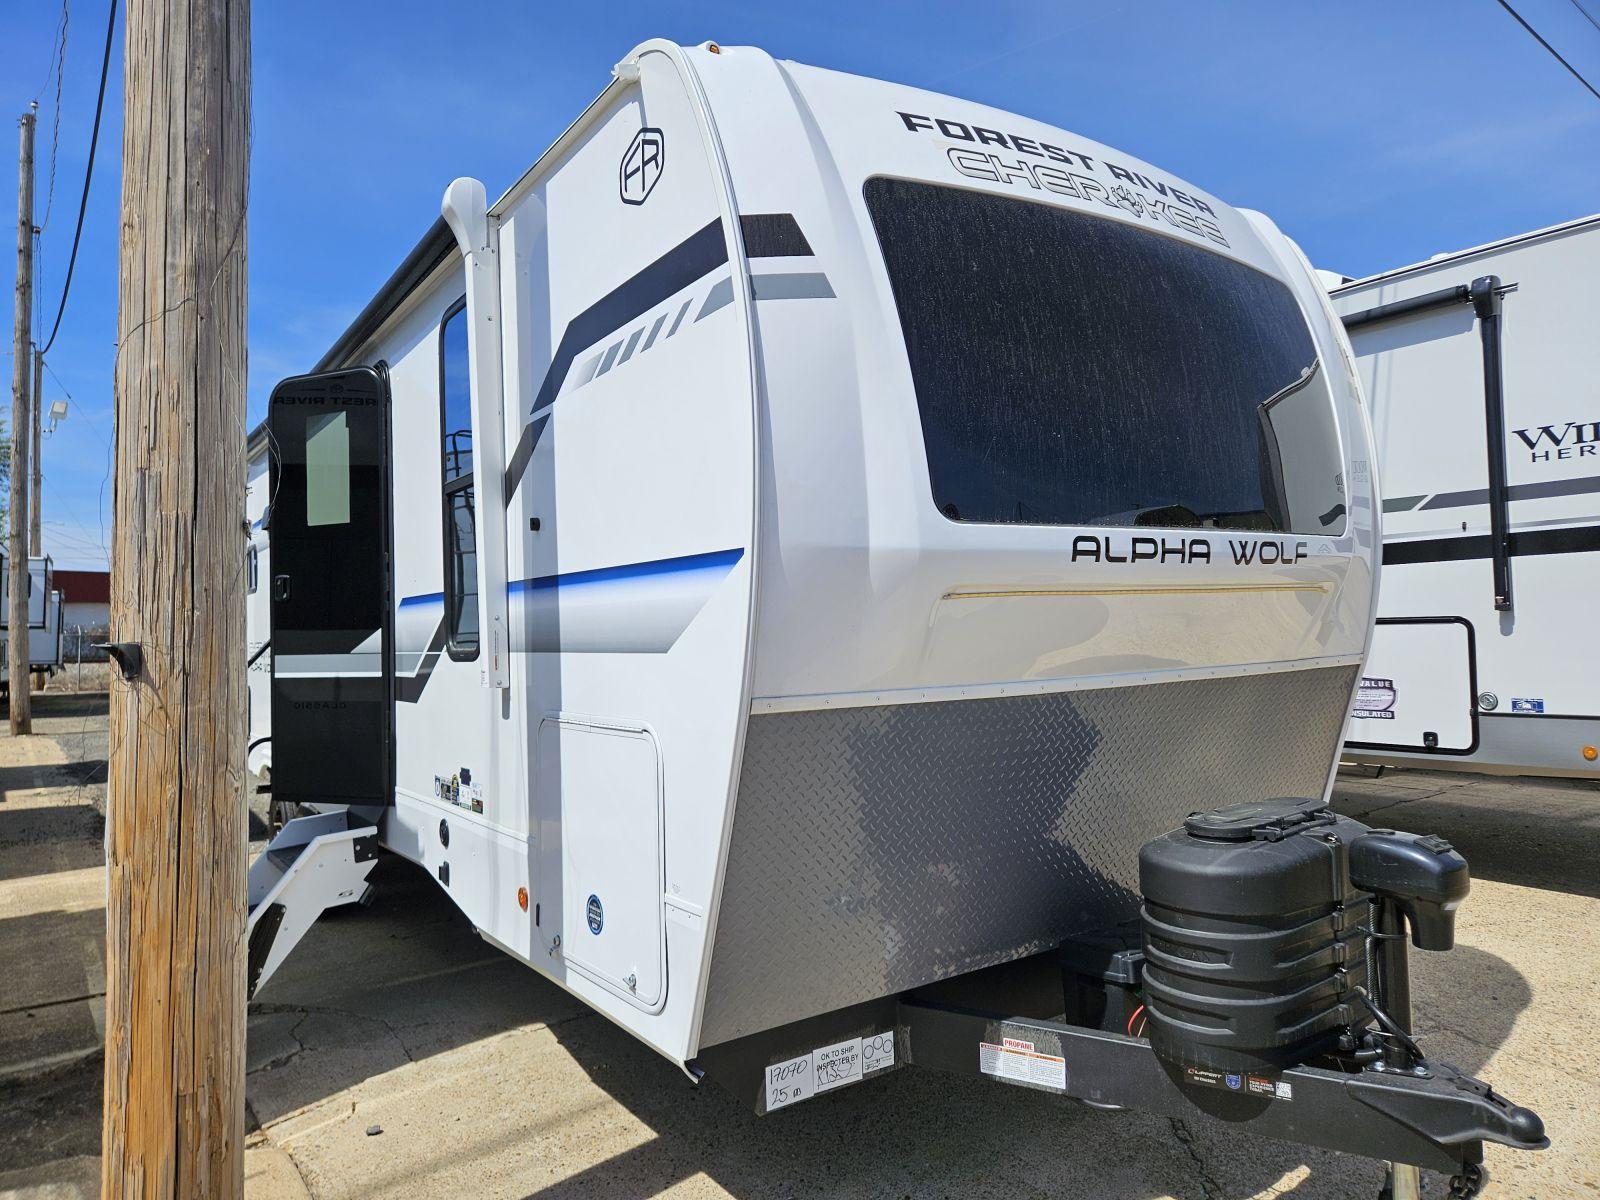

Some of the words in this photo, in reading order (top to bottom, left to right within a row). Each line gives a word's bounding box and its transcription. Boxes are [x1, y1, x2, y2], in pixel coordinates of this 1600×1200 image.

[895, 111, 1094, 170] FOREST
[1103, 160, 1218, 219] RIVER
[1532, 444, 1597, 462] HER
[1071, 535, 1211, 564] ALPHA
[1229, 539, 1307, 565] WOLF
[821, 1052, 831, 1061] OK
[840, 1045, 855, 1056] SHIP
[1005, 1039, 1034, 1051] PROPANE
[816, 1056, 850, 1071] INSPECTED
[850, 1052, 859, 1062] BY
[770, 1059, 808, 1085] 17070
